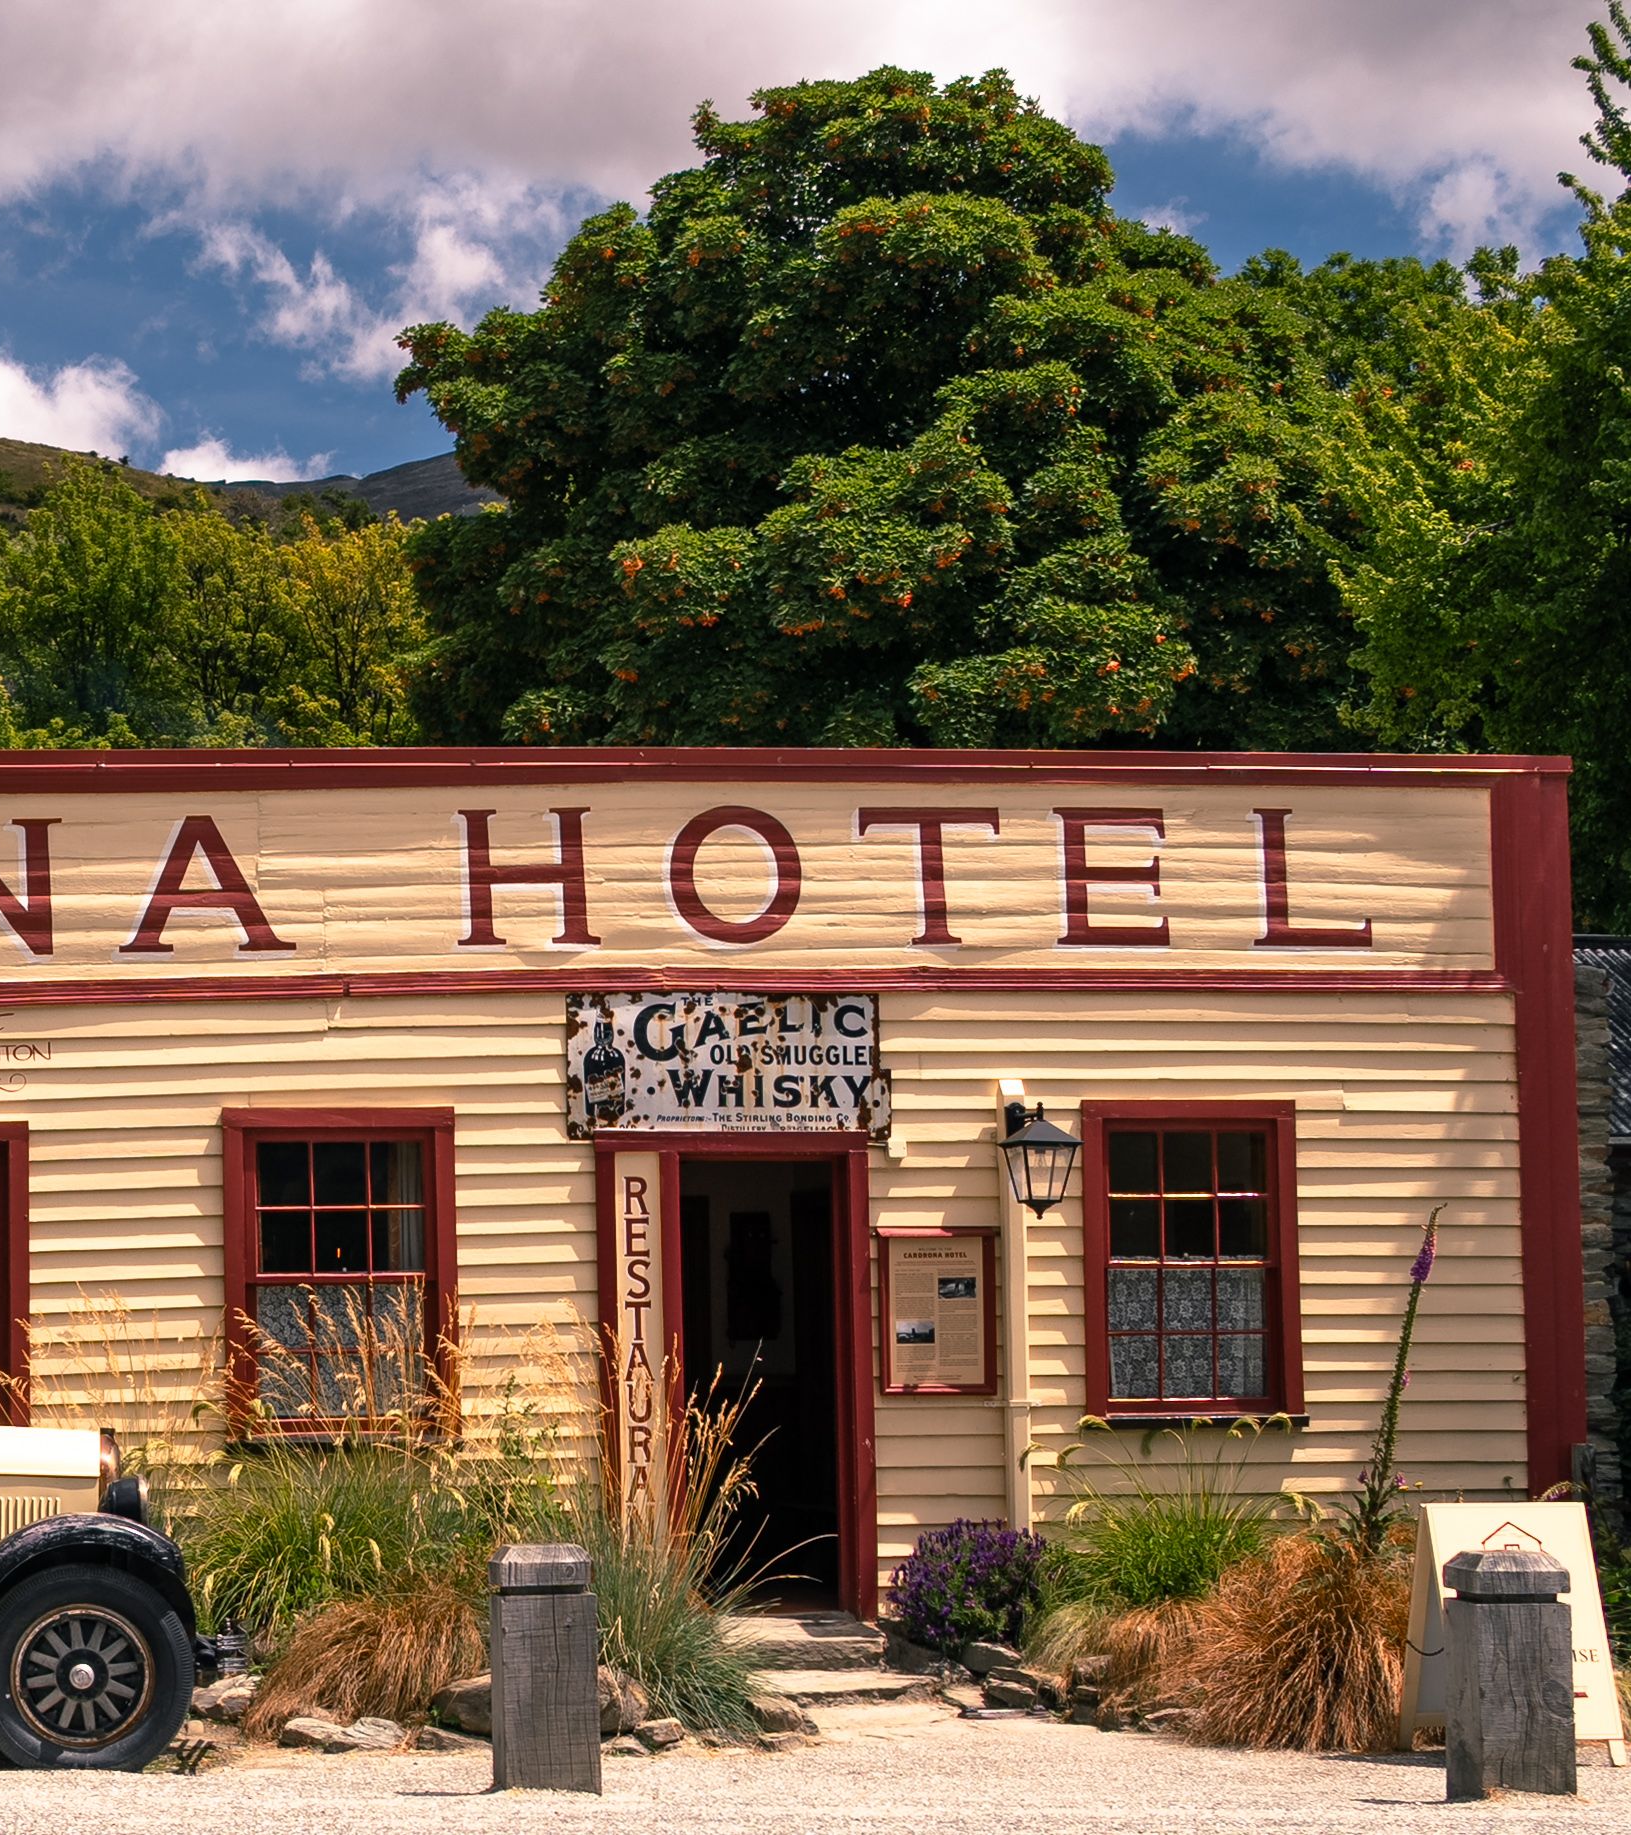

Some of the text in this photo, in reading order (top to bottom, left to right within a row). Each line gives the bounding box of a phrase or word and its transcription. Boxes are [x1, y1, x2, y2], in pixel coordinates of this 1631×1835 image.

[454, 804, 1373, 948] HOTEL
[681, 996, 713, 1006] THE
[633, 1001, 869, 1062] GAELIC
[667, 1068, 872, 1109] WHISKY
[735, 1113, 782, 1123] STIRLING
[786, 1113, 832, 1123] BONDING
[622, 1176, 655, 1545] RESTAURAN
